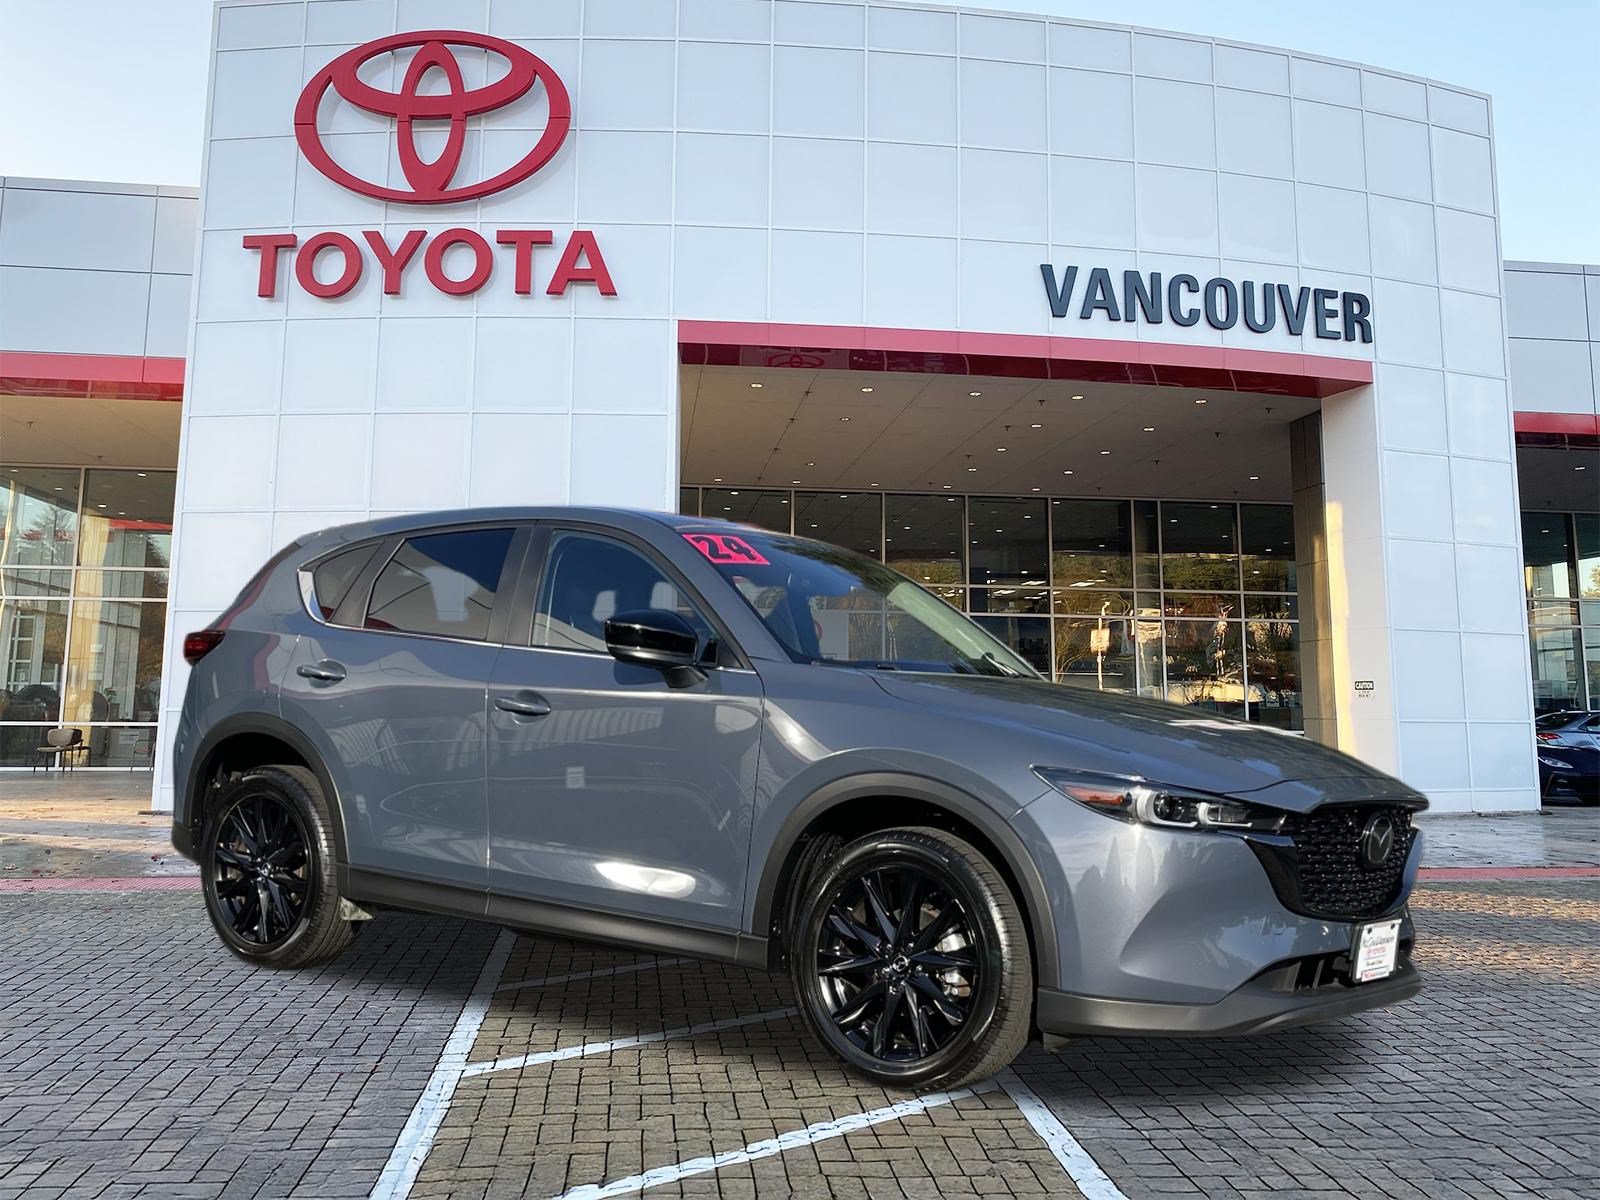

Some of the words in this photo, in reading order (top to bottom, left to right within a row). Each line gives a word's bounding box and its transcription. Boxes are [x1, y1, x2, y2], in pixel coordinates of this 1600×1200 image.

[243, 228, 618, 298] TOYOTA
[1040, 264, 1373, 343] VANCOUVER
[691, 535, 757, 561] 24
